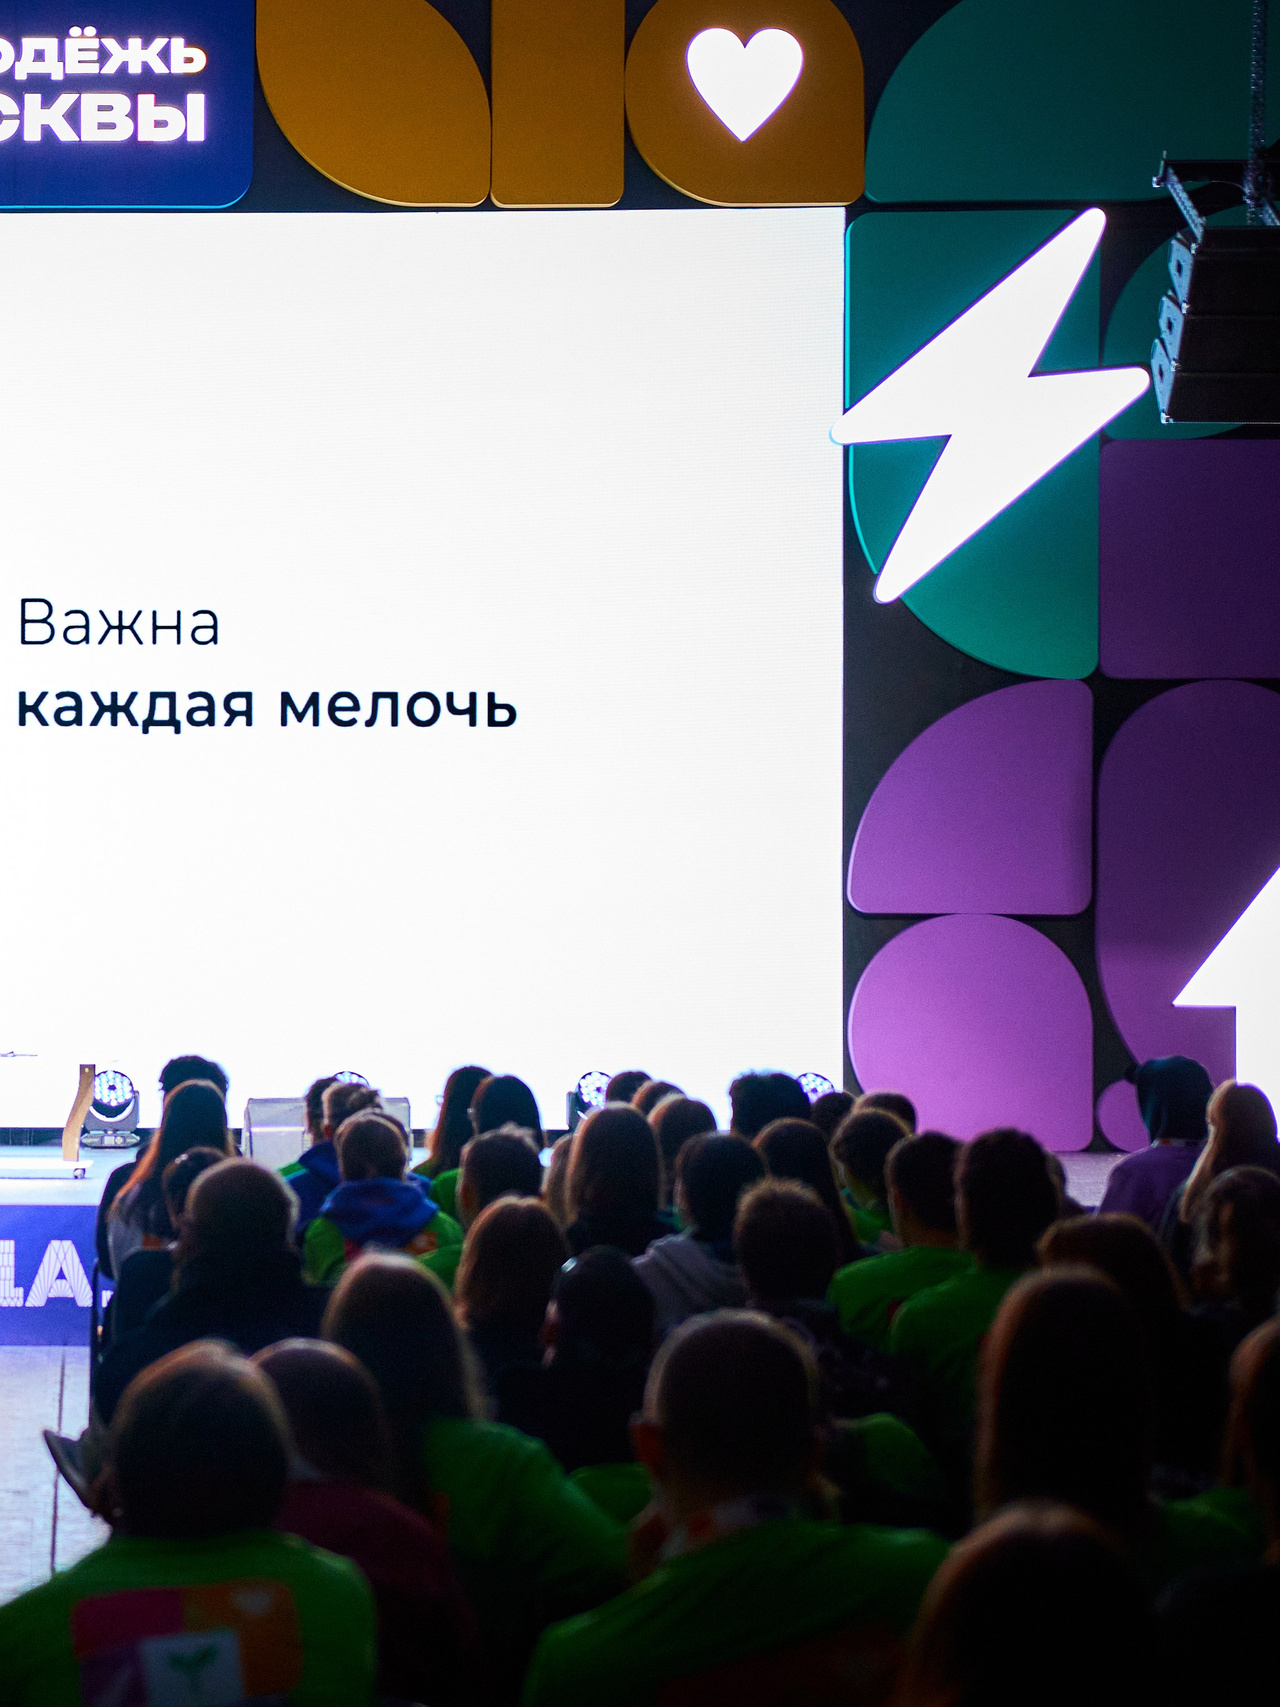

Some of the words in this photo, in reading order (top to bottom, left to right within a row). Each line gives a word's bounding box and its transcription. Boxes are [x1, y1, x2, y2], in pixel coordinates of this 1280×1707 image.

[20, 597, 219, 646] Важна
[18, 690, 253, 735] каждая
[280, 690, 518, 728] мелочь
